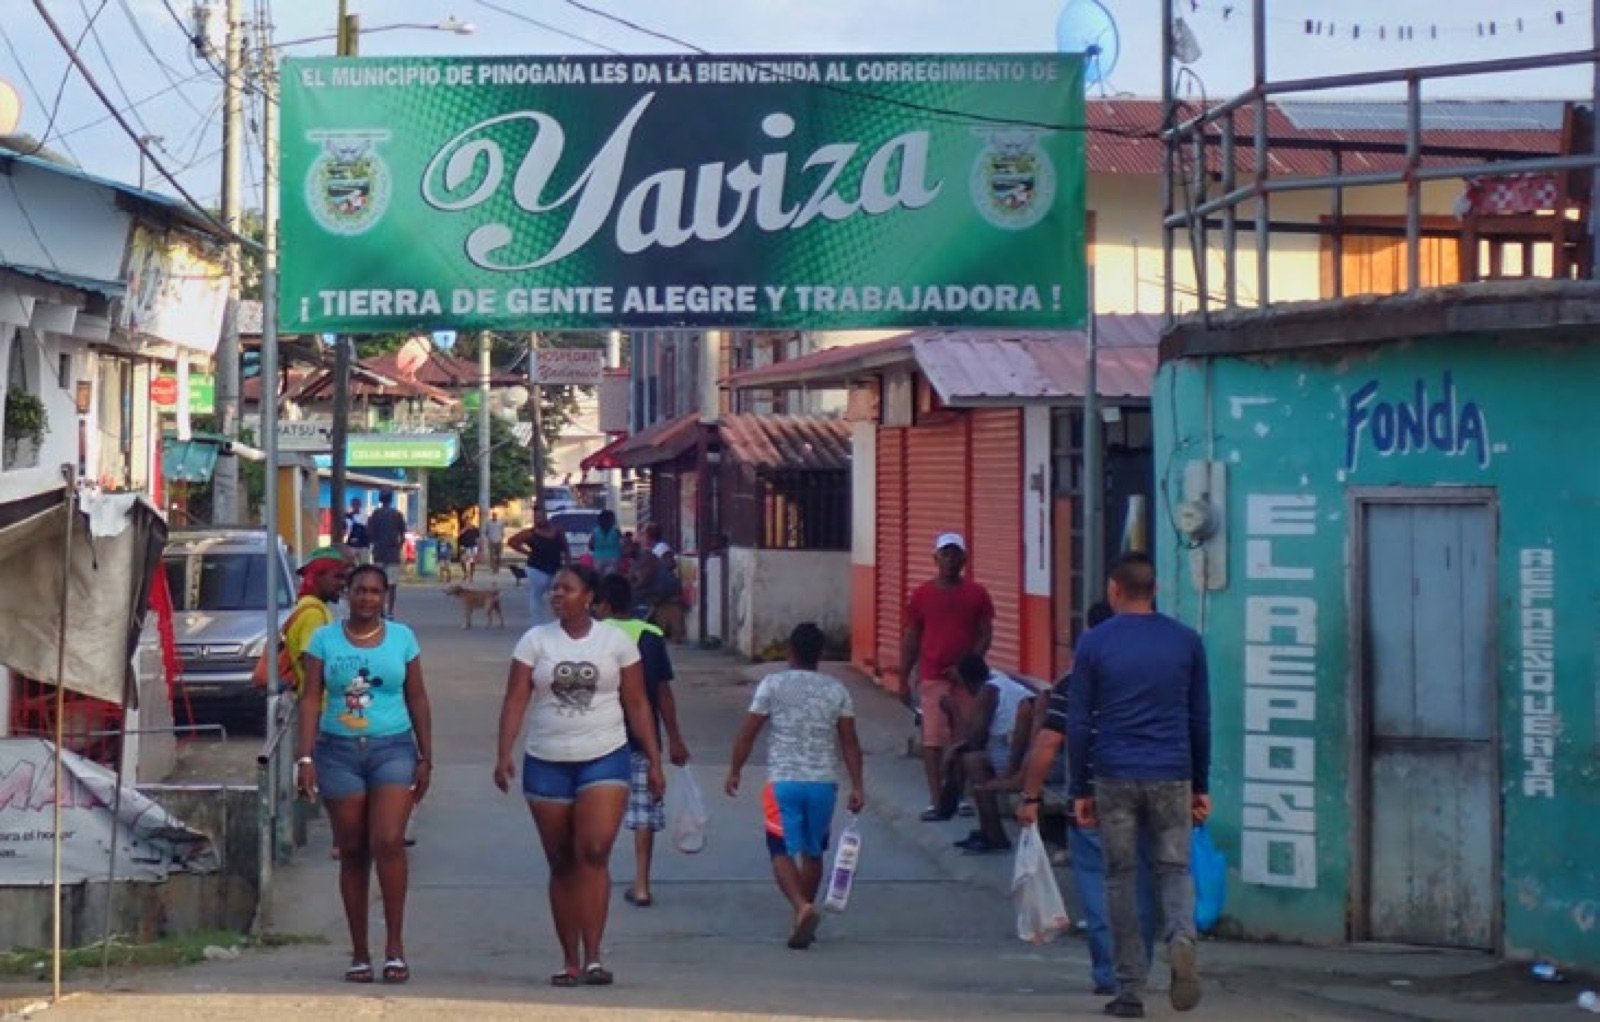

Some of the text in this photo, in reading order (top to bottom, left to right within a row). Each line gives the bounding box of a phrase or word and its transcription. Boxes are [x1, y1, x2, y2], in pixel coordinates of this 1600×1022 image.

[302, 67, 325, 87] EL
[332, 66, 440, 87] MUNICIPIO
[446, 65, 473, 85] DE
[590, 62, 628, 84] LES
[632, 62, 661, 83] DA
[666, 61, 692, 83] LA
[696, 61, 820, 83] BIENVENIDA
[826, 61, 851, 83] AL
[856, 61, 1025, 82] CORREGIMIENTO
[1030, 62, 1059, 81] DE
[421, 91, 943, 271] Yaviza
[319, 290, 442, 316] TIERRA
[452, 289, 497, 314] DE
[506, 288, 613, 313] GENTE
[623, 287, 756, 312] ALEGRE
[764, 286, 788, 312] Y
[794, 285, 1042, 312] TRABAJADORA
[1246, 493, 1316, 580] EL
